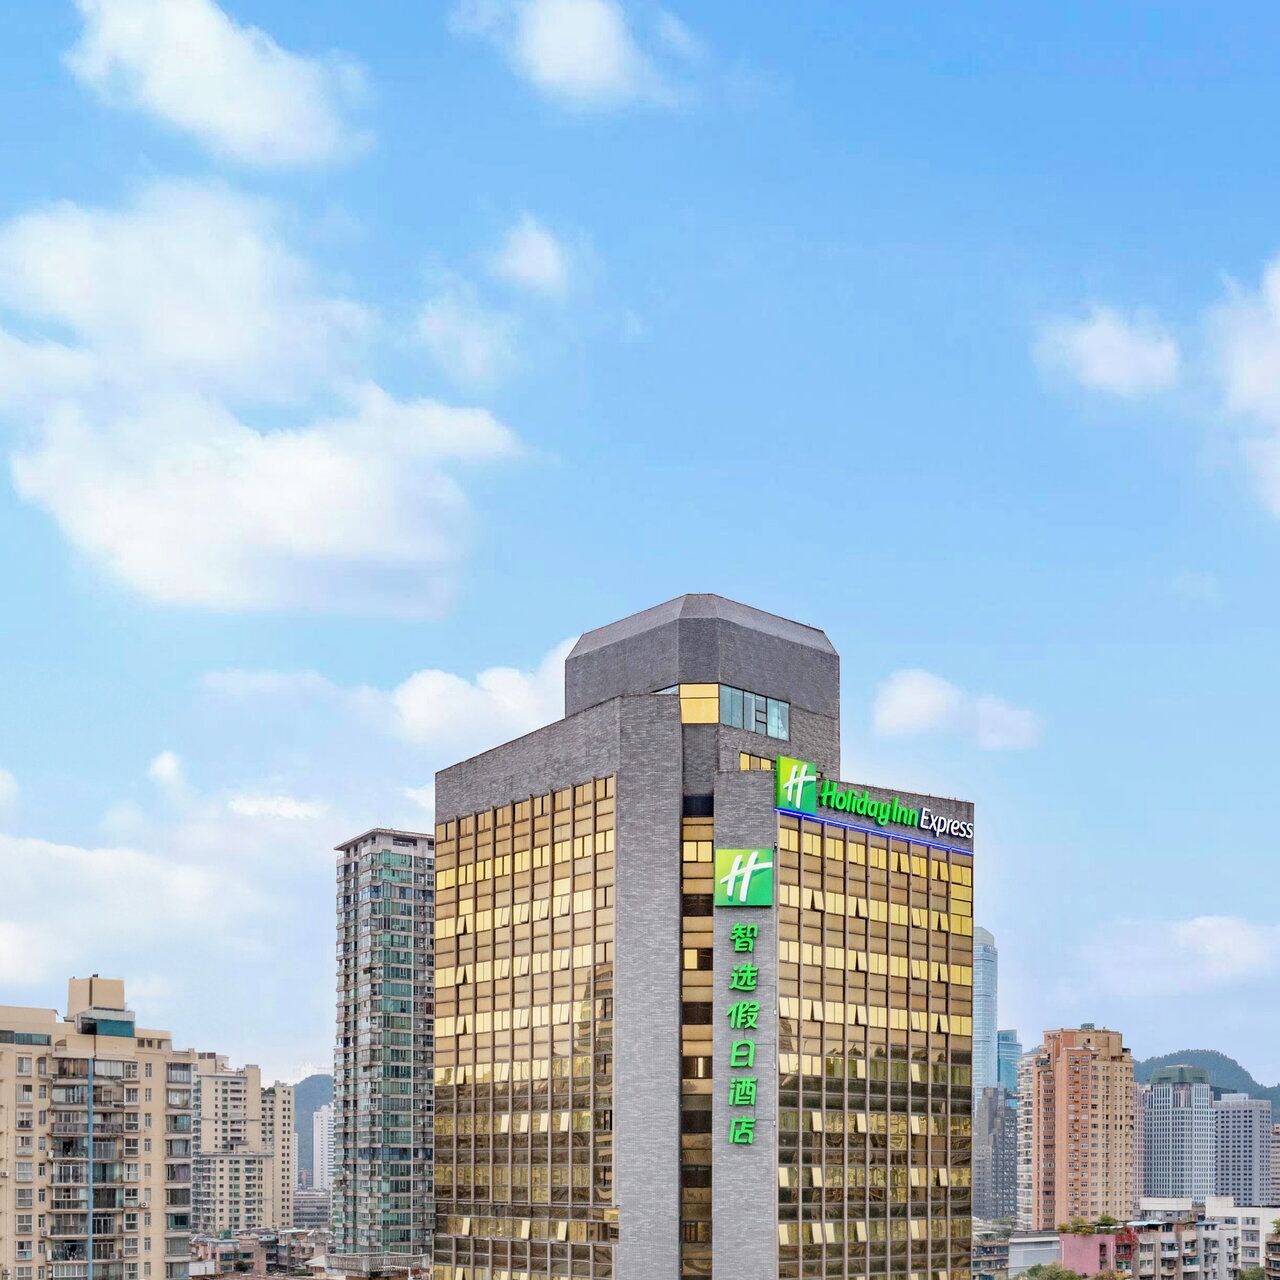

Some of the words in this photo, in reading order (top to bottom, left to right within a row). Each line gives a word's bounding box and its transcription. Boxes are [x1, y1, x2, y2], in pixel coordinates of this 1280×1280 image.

[818, 779, 891, 826] Holiday
[891, 797, 919, 827] Inn
[919, 807, 974, 839] Express
[726, 921, 761, 1147] 智选假日酒店
